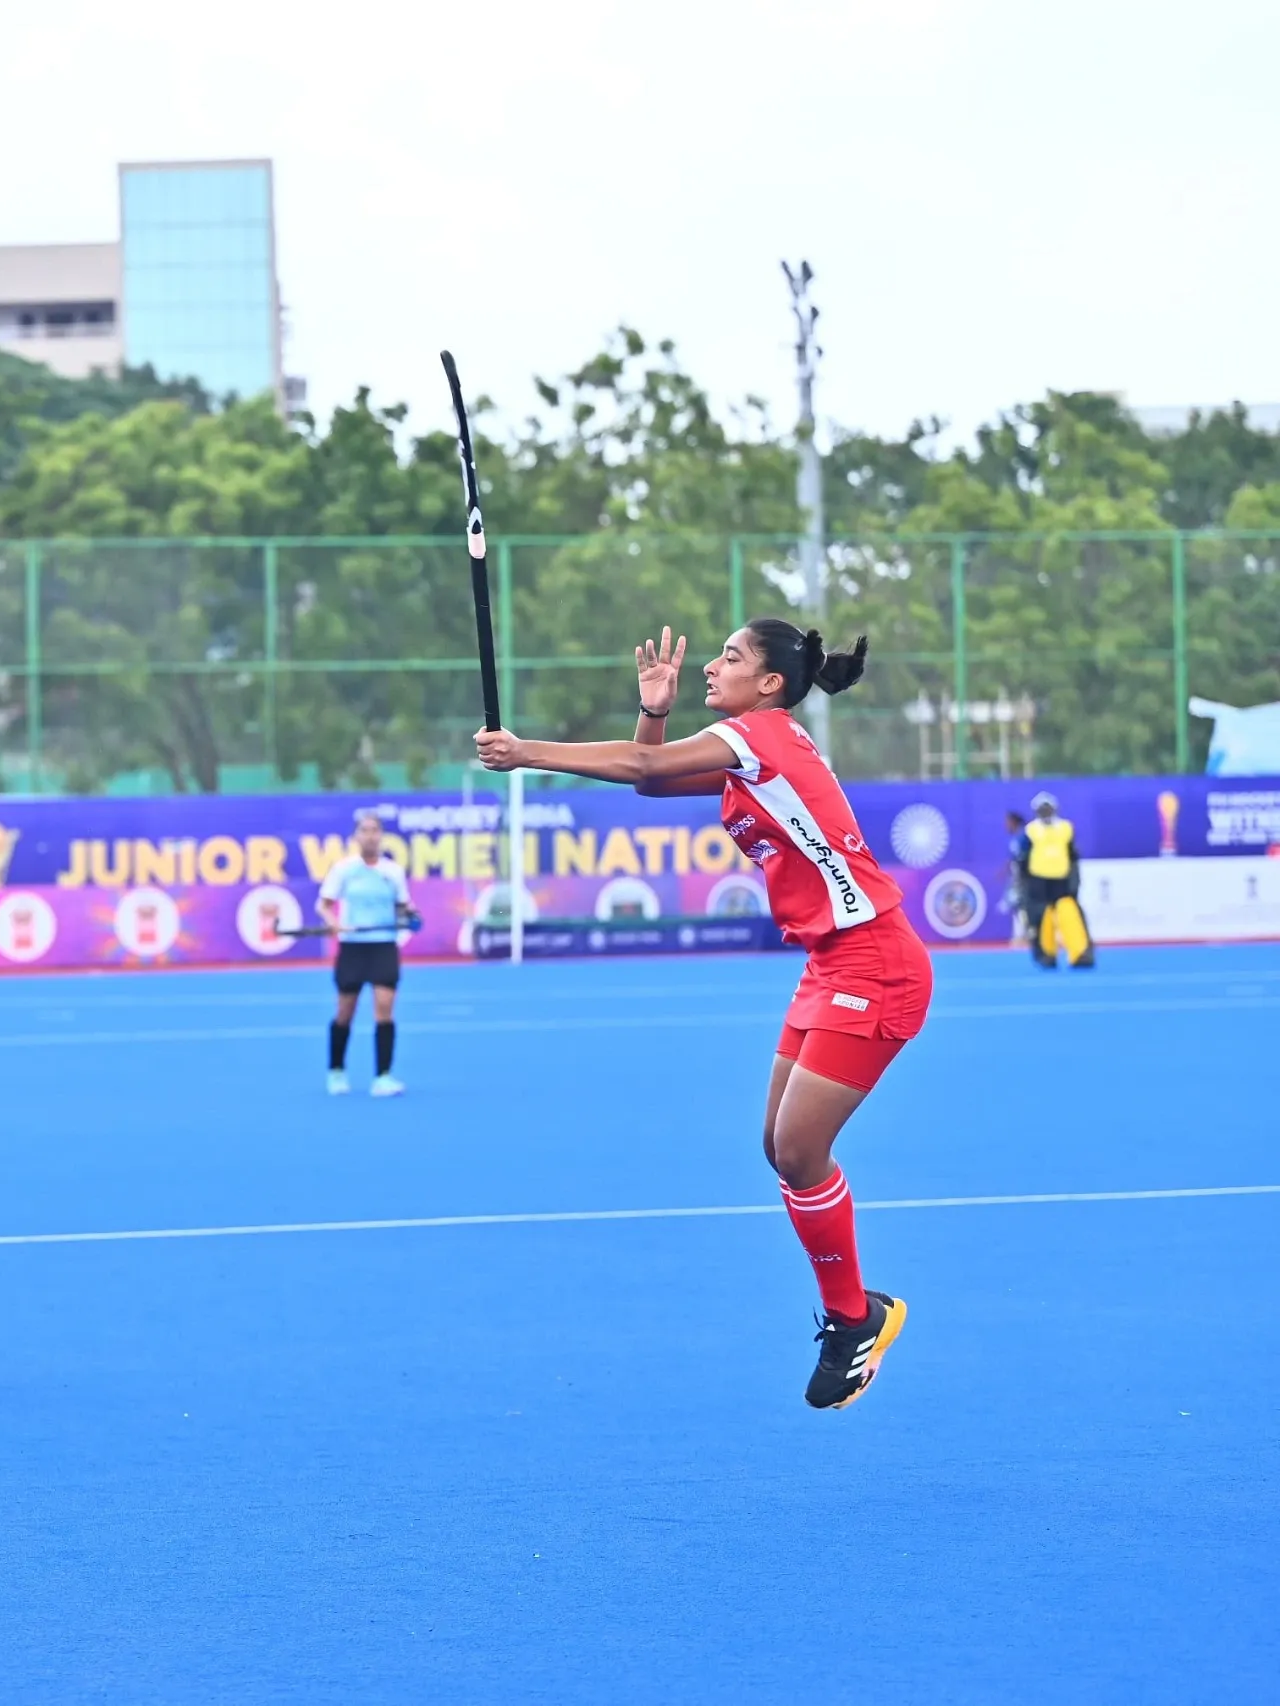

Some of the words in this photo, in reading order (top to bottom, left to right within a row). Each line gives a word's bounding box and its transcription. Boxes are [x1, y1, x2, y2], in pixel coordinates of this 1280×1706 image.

[504, 803, 574, 828] IDIA
[57, 834, 288, 888] JUNIOR
[554, 824, 758, 878] NATIO
